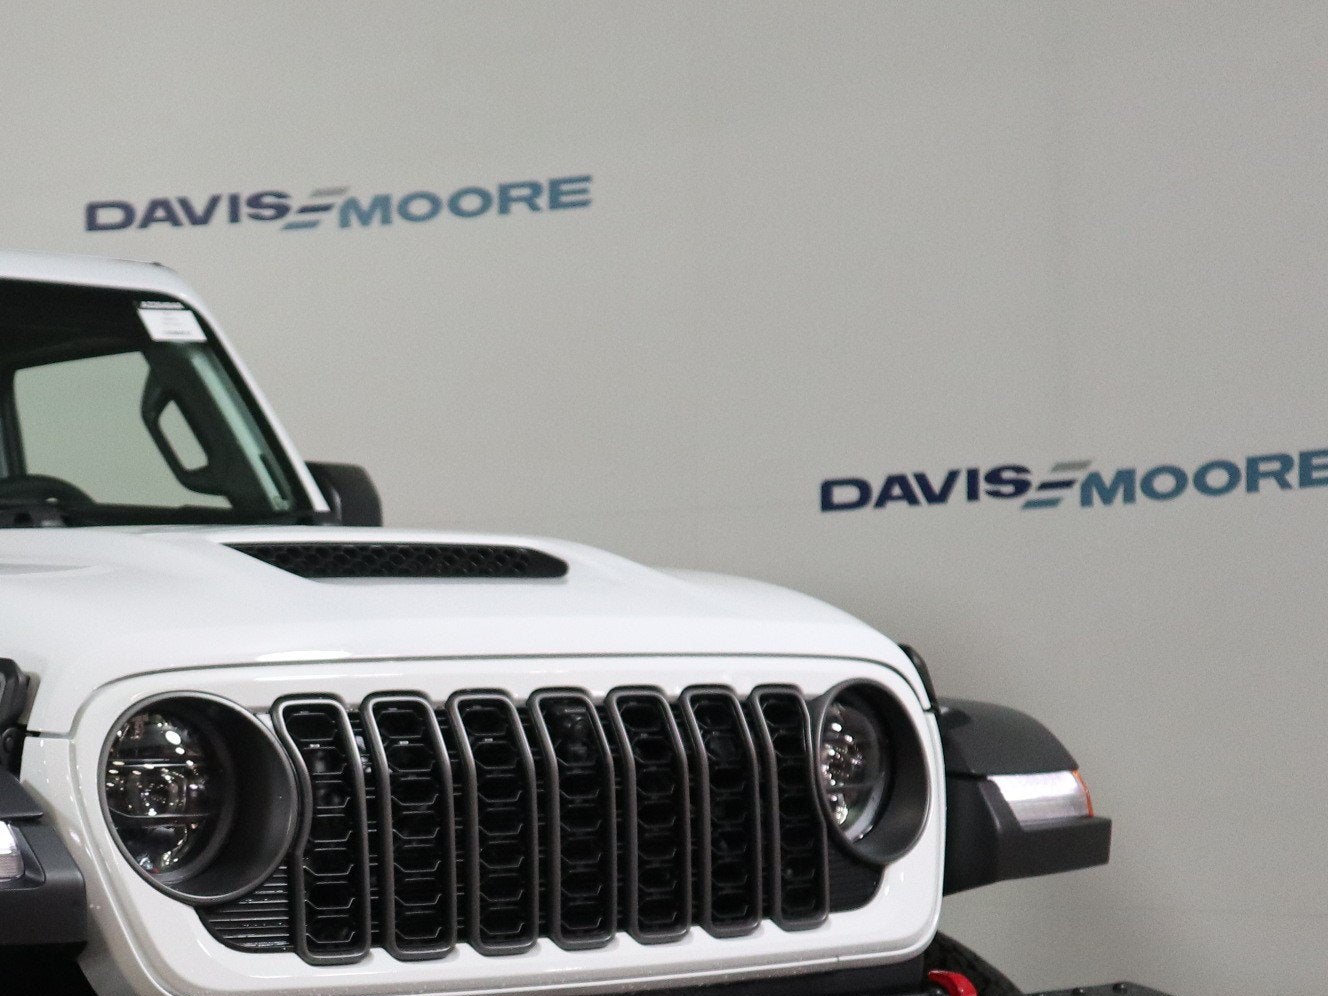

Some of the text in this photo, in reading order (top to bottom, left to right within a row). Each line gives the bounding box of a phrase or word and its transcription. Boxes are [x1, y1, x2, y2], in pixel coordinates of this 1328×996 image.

[85, 174, 593, 233] DAVIS MOORE
[819, 448, 1328, 513] DAVIS MOORE
